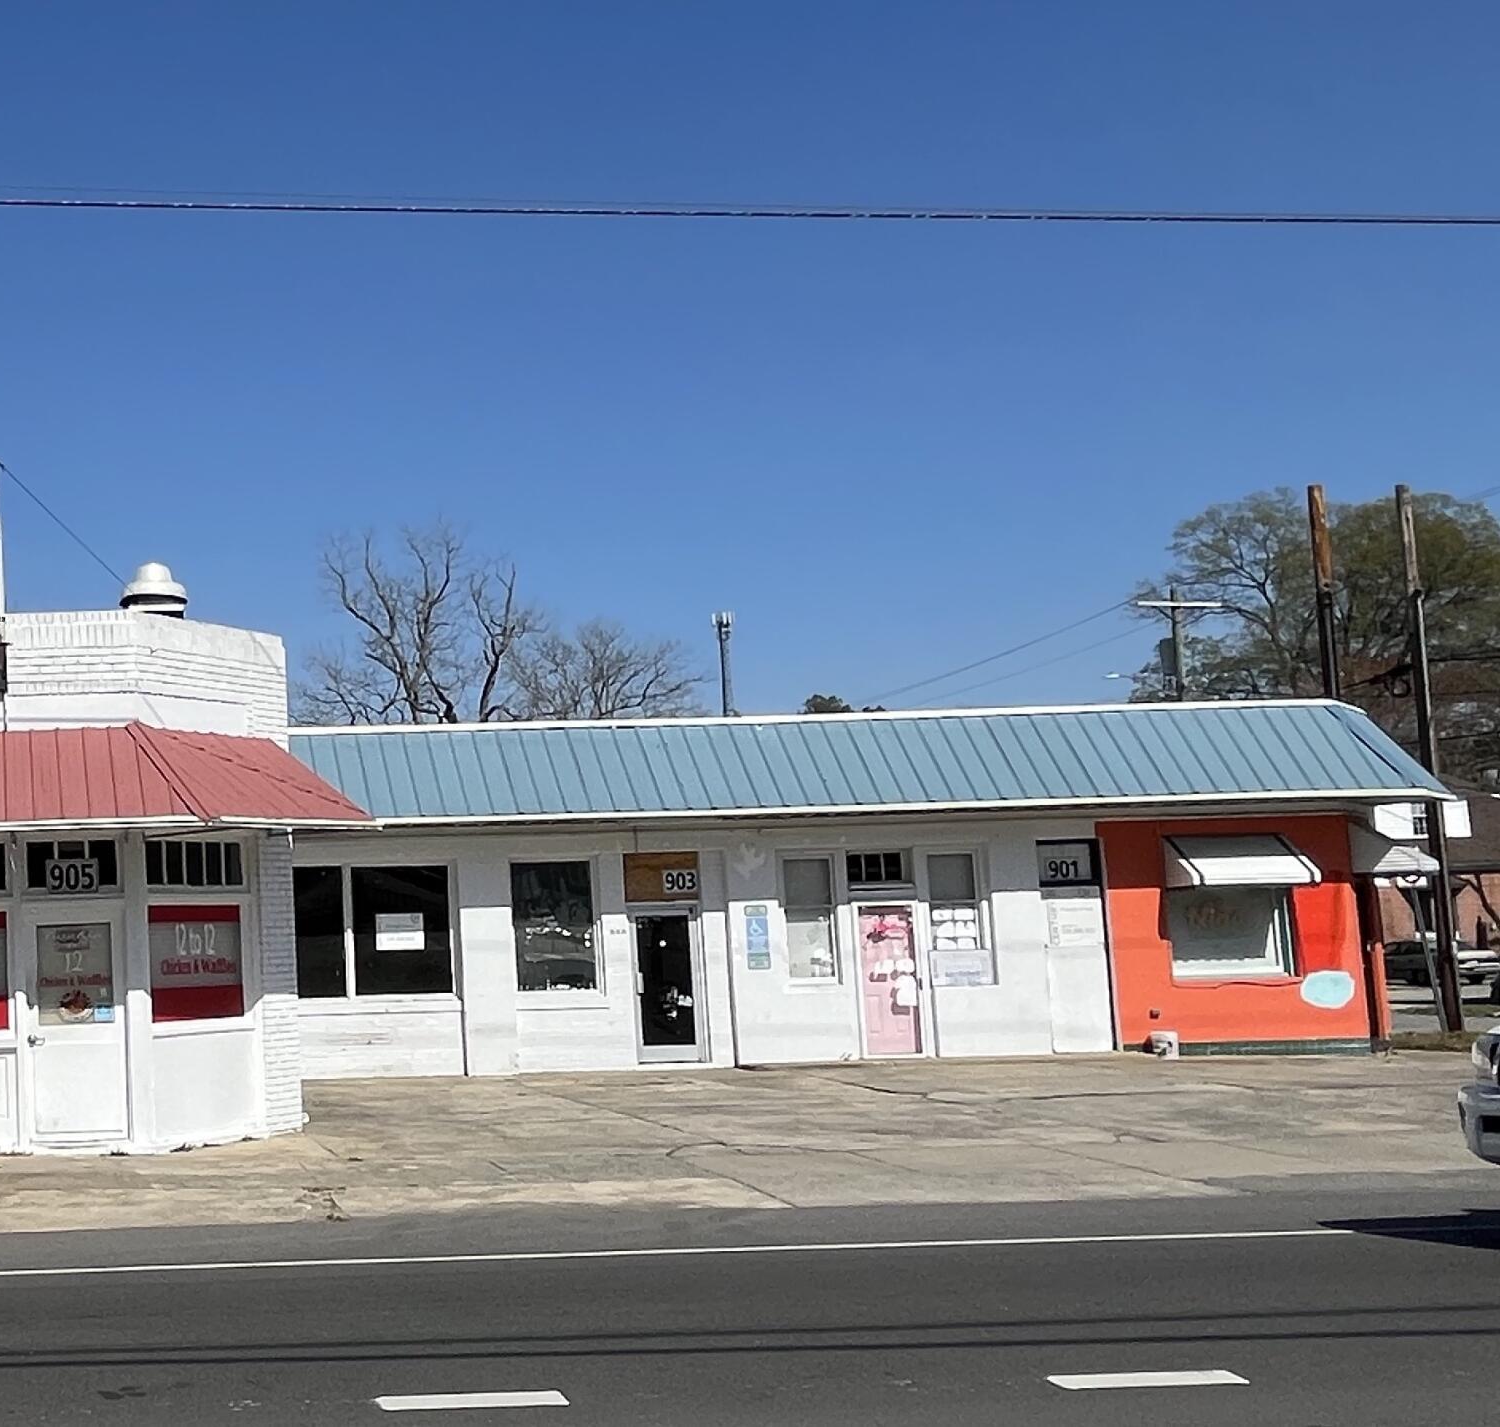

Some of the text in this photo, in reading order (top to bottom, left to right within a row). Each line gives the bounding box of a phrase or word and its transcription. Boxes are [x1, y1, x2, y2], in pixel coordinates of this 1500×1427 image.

[49, 863, 95, 890] 905
[1047, 860, 1079, 878] 901
[665, 872, 696, 890] 903
[175, 922, 188, 955] 12
[203, 922, 216, 955] 12
[64, 950, 84, 972] 12
